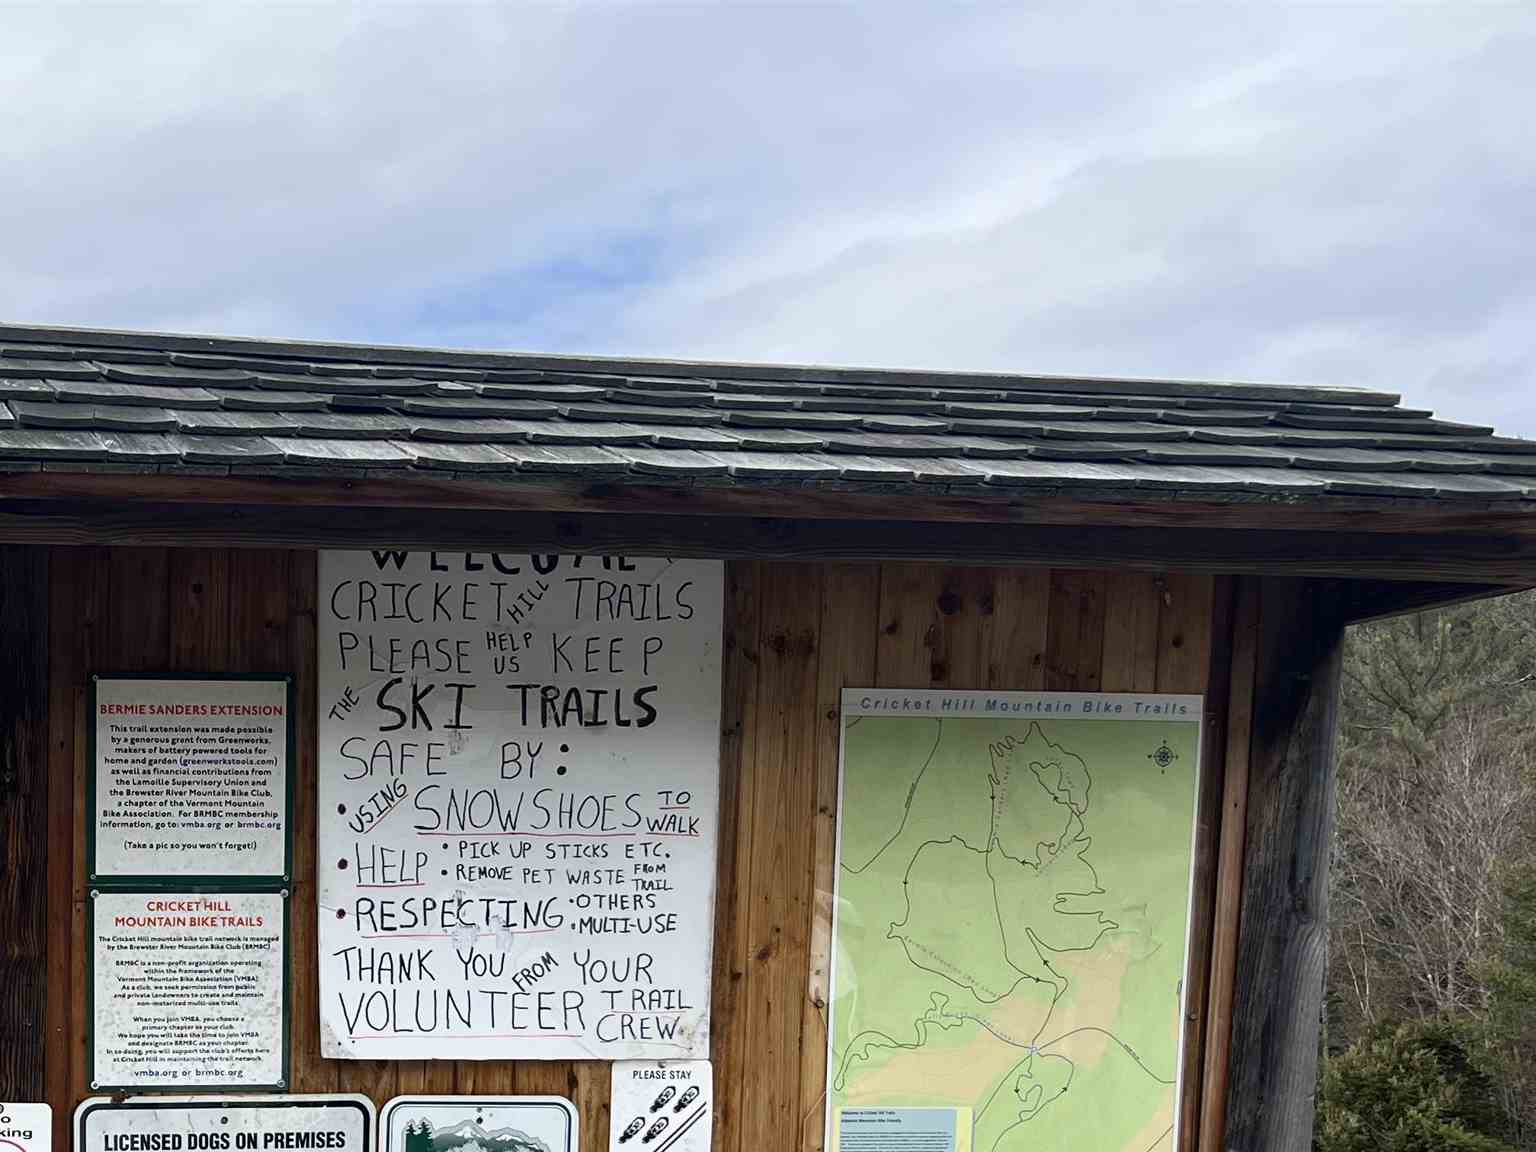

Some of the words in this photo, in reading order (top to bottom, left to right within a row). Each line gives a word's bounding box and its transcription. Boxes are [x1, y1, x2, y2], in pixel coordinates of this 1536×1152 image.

[331, 580, 508, 623] CRICKET
[506, 580, 549, 624] HILL
[564, 578, 694, 621] TRAILS
[339, 632, 472, 674] PLEASE
[486, 632, 532, 652] HELP
[552, 634, 663, 674] KEEP
[494, 656, 520, 674] US
[150, 705, 207, 715] SANDERS
[211, 705, 283, 715] EXTENSION
[329, 686, 360, 721] THE
[378, 678, 476, 731] SKI
[506, 685, 658, 729] TRAILS
[861, 698, 931, 710] Cricket
[942, 699, 975, 711] Hill
[985, 701, 1073, 712] Mountain
[1083, 702, 1123, 713] Bike
[1134, 703, 1188, 714] Trails
[110, 725, 127, 733] This
[150, 726, 192, 734] extension
[237, 727, 273, 736] possible
[340, 737, 447, 780] SAFE
[348, 778, 407, 834] USING
[414, 785, 642, 833] SNOWSHOES
[658, 791, 691, 806] TO
[646, 815, 703, 834] WALK
[124, 842, 146, 850] (Take
[156, 842, 168, 850] pic
[355, 843, 428, 883] HELP
[459, 841, 501, 859] PICK
[510, 843, 532, 857] UP
[545, 843, 609, 858] STICKS
[624, 843, 671, 859] ETC.
[456, 866, 513, 881] REMOVE
[523, 869, 556, 884] PET
[567, 869, 625, 885] WASTE
[633, 864, 666, 875] FROM
[632, 878, 673, 890] TRAIL
[147, 902, 200, 912] CRICKET
[204, 902, 231, 911] HILL
[355, 897, 563, 932] RESPECTING
[576, 894, 656, 910] OTHERS
[115, 917, 186, 927] MOUNTAIN
[190, 917, 217, 927] BIKE
[219, 917, 263, 926] TRAILS
[578, 914, 677, 933] MULTI-USE
[333, 946, 436, 983] THANK
[456, 948, 505, 977] YOU
[512, 952, 559, 992] FROM
[574, 949, 654, 984] YOUR
[339, 989, 586, 1035] VOLUNTEER
[600, 989, 692, 1011] TRAIL
[596, 1013, 679, 1042] CREW
[135, 1069, 178, 1078] vmba.org
[196, 1069, 243, 1078] brmbc.org
[633, 1071, 666, 1079] PLEASE
[670, 1071, 692, 1079] STAY
[104, 1134, 182, 1151] LICENSED
[188, 1133, 230, 1150] DOGS
[236, 1133, 258, 1150] ON
[264, 1132, 346, 1150] PREMISES
